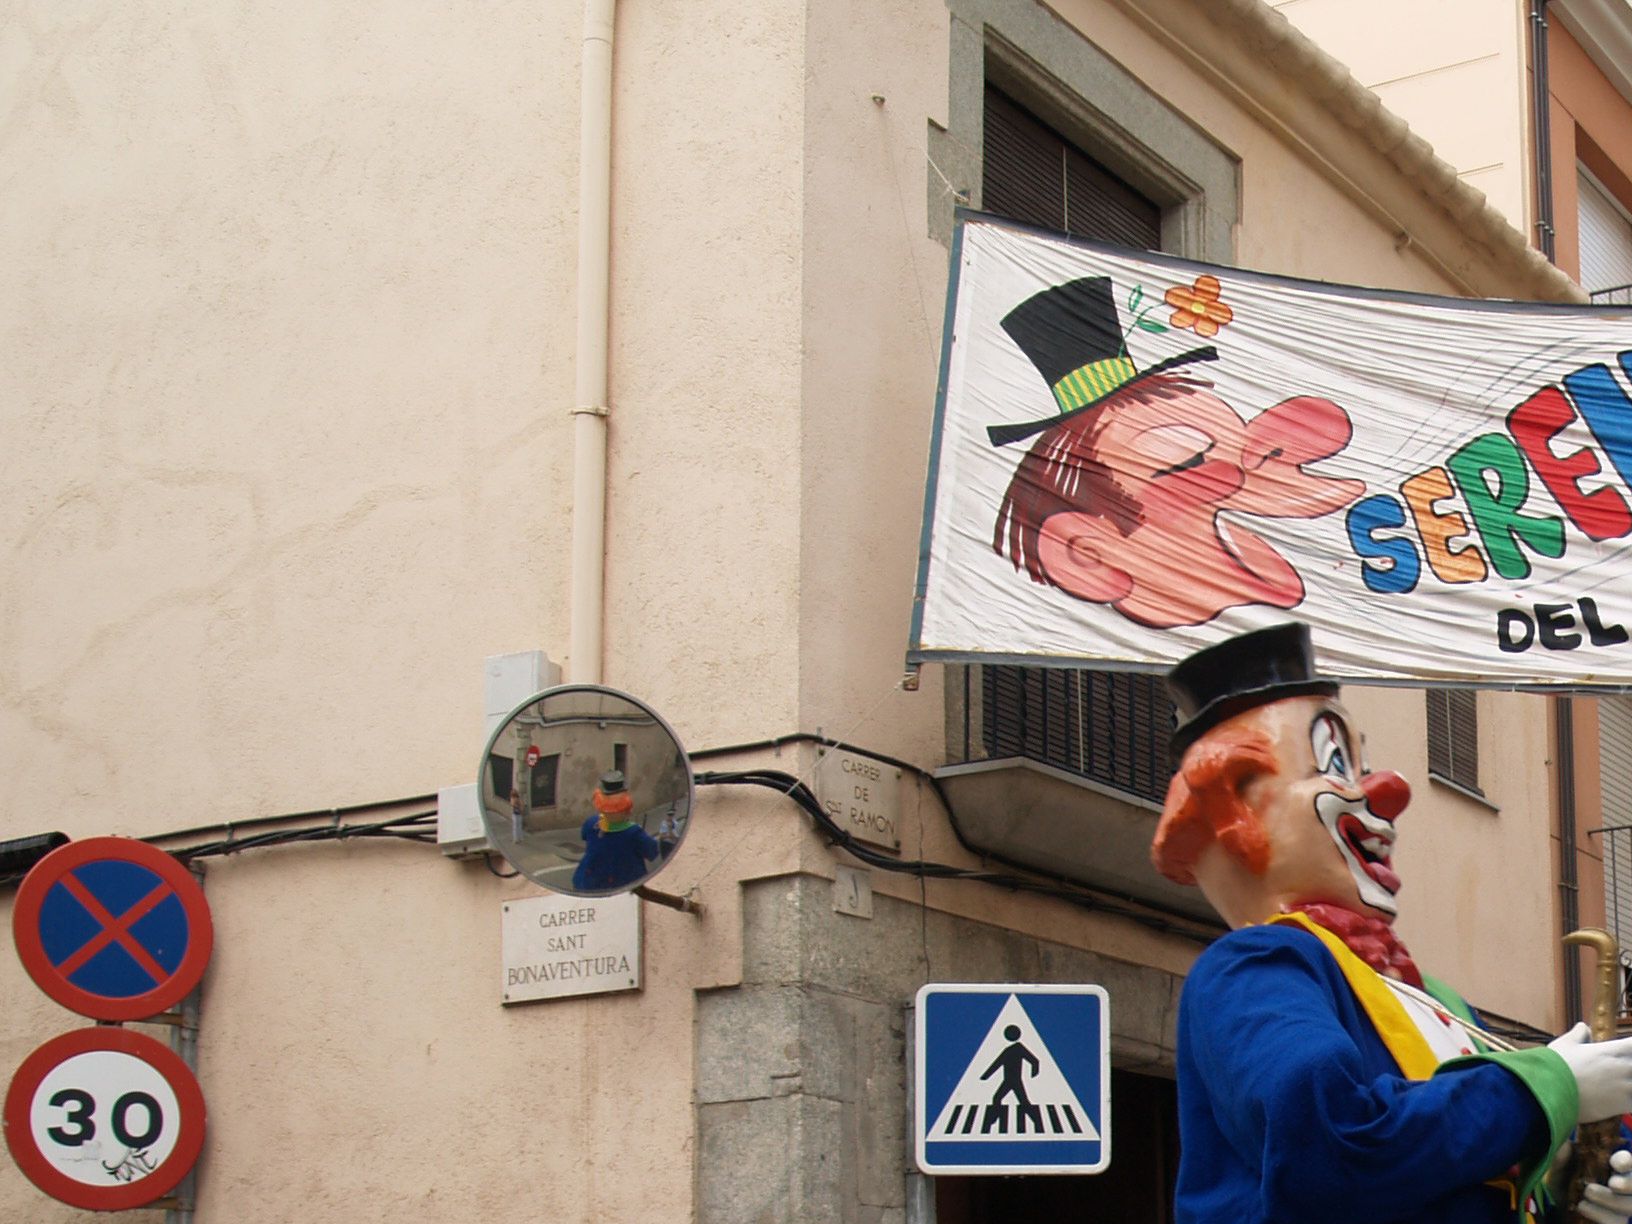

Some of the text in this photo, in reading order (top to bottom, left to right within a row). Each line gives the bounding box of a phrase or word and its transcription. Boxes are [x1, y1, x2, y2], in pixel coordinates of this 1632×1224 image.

[1497, 593, 1627, 653] DEL
[841, 758, 882, 783] CARRER
[854, 785, 869, 802] DE
[851, 807, 896, 835] RAMON
[539, 908, 597, 929] CARRER
[547, 934, 587, 952] SANT
[508, 954, 631, 986] BONAVENTURA
[47, 1088, 164, 1149] 30
